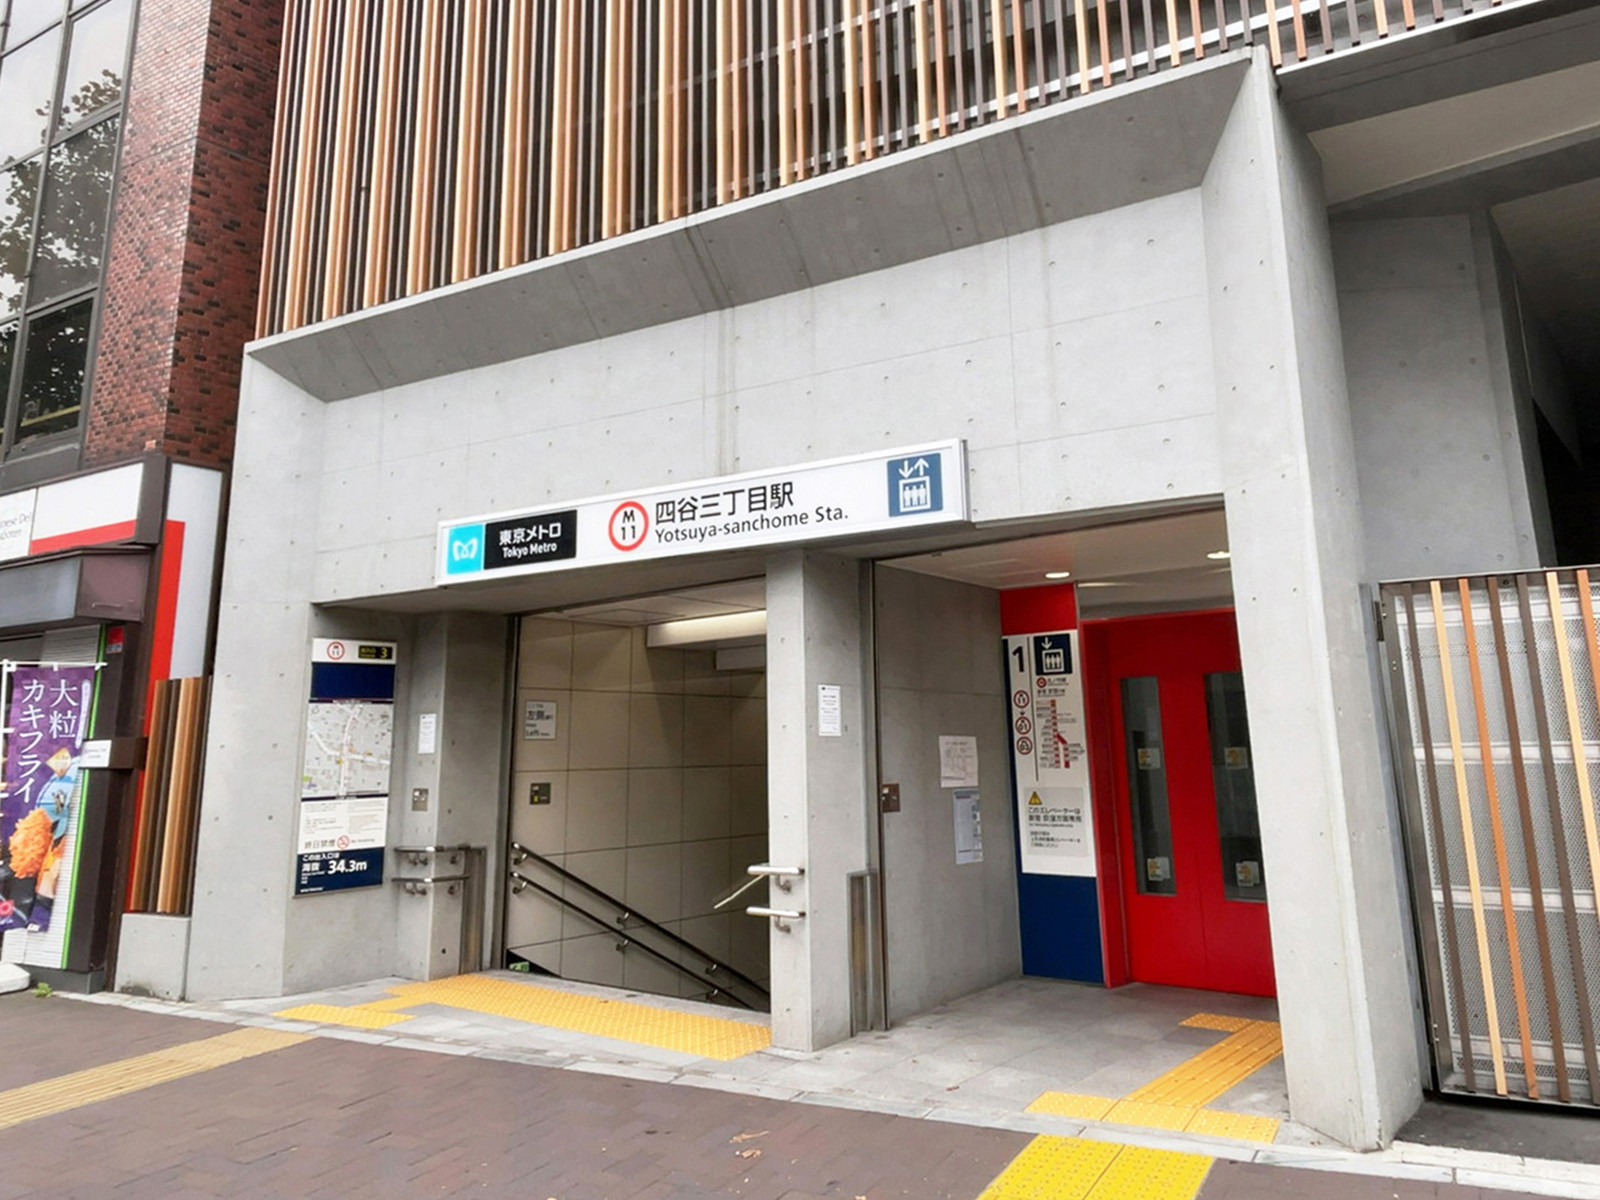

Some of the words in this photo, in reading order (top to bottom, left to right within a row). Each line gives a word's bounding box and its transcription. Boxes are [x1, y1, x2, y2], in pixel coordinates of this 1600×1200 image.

[656, 481, 794, 526] 四谷三丁目駅
[622, 509, 635, 523] M
[655, 511, 809, 544] Yotsuya-sanchome
[815, 505, 848, 523] Sta.
[499, 522, 562, 546] 東京メトロ
[620, 525, 637, 541] 11
[502, 546, 529, 560] Tokyo
[530, 541, 558, 555] Metro
[381, 647, 388, 659] 3
[1012, 646, 1024, 673] 1
[49, 679, 79, 739] 大粒
[13, 679, 45, 803] カキフライ
[327, 860, 368, 875] 34.3m
